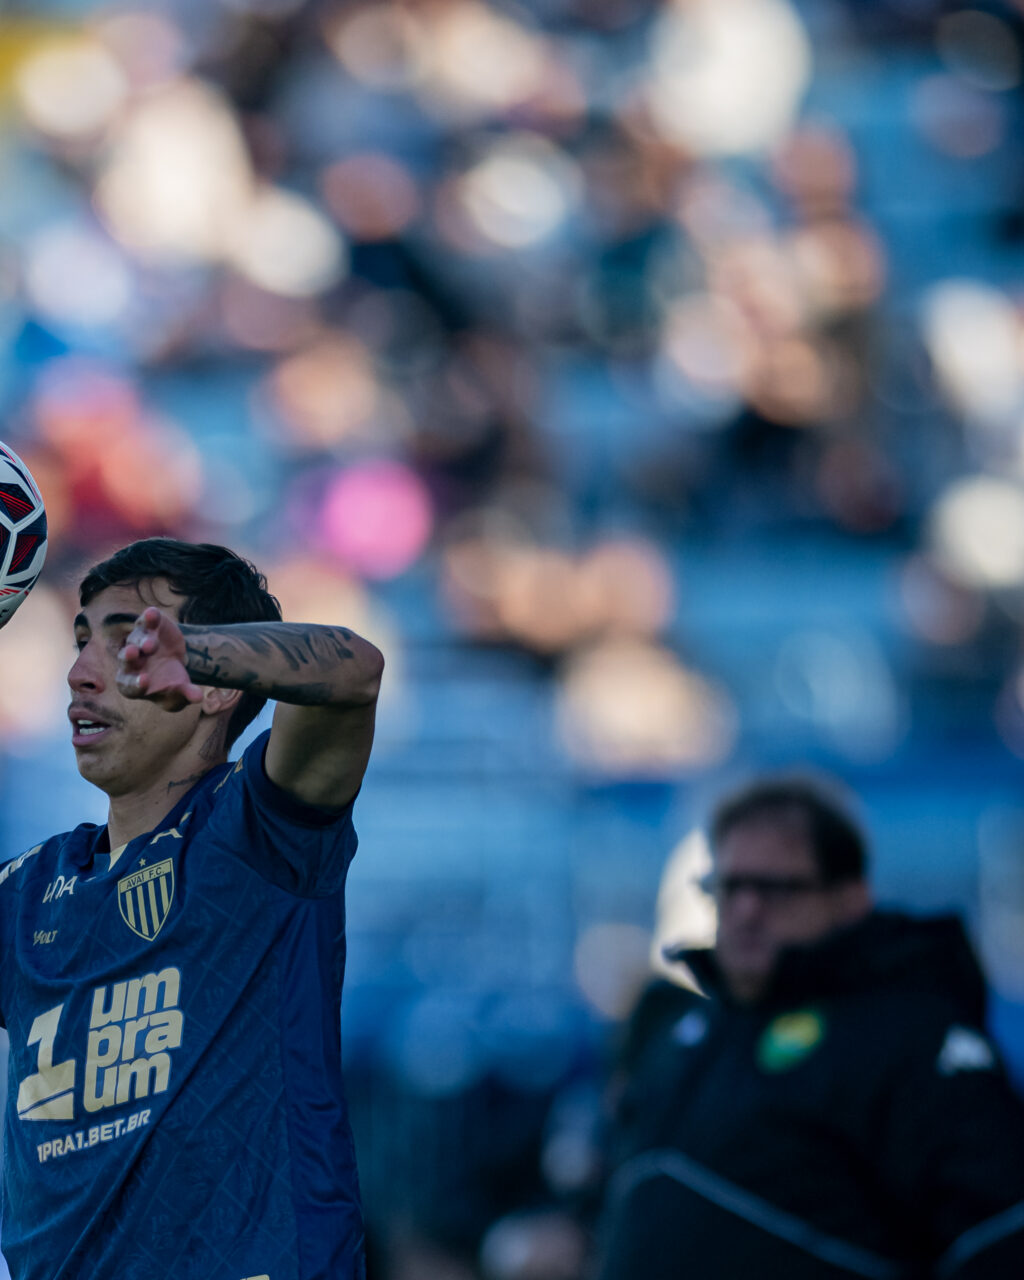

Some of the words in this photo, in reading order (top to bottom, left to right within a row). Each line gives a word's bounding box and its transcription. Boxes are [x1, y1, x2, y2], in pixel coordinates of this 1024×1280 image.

[33, 930, 58, 946] VOLT
[89, 967, 180, 1030] um
[86, 1009, 183, 1070] pra
[83, 1052, 170, 1112] um
[37, 1108, 152, 1163] 1PRA1.BET.BR
